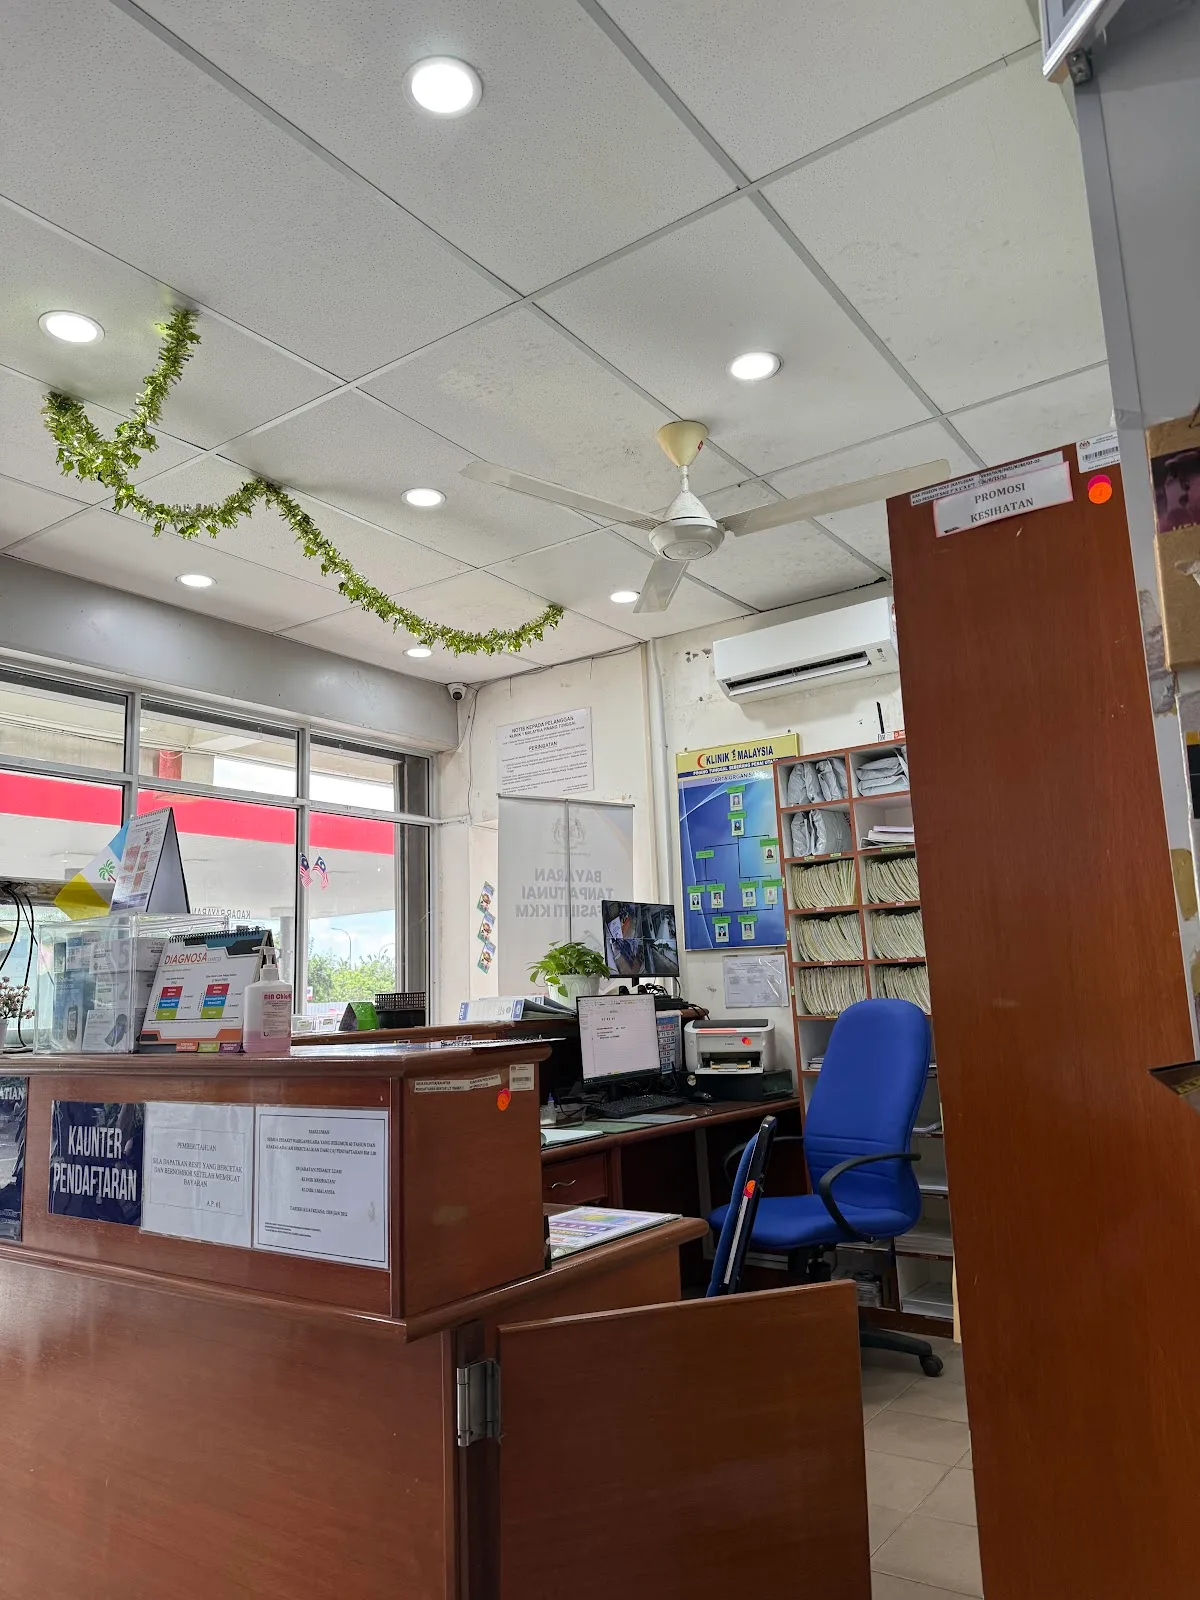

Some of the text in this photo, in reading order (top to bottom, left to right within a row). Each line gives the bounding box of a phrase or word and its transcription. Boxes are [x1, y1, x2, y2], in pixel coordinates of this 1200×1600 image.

[974, 482, 1026, 504] PROMOSI
[970, 497, 1034, 524] KESIHATAN
[512, 726, 525, 734] NOTIS
[526, 721, 544, 730] KEPADA
[529, 741, 558, 751] PERINGATAN
[706, 752, 730, 765] KLINIK
[737, 745, 774, 761] MALAYSIA
[709, 766, 729, 774] TUNGGAL
[729, 763, 751, 771] SEBERANG
[164, 952, 208, 965] DIAGNOSA
[68, 1125, 123, 1159] KAUNTER
[177, 1141, 217, 1152] PEMBERITAHUAN
[152, 1157, 162, 1165] SILA
[163, 1158, 188, 1167] DAPATKAN
[203, 1162, 216, 1171] YANG
[217, 1163, 243, 1173] BERCETAK
[53, 1162, 137, 1202] PENDAFTARAN
[154, 1166, 241, 1183] DAN BERNOMBOR SETELAH MEMBUAT
[183, 1178, 208, 1188] BAYARAN
